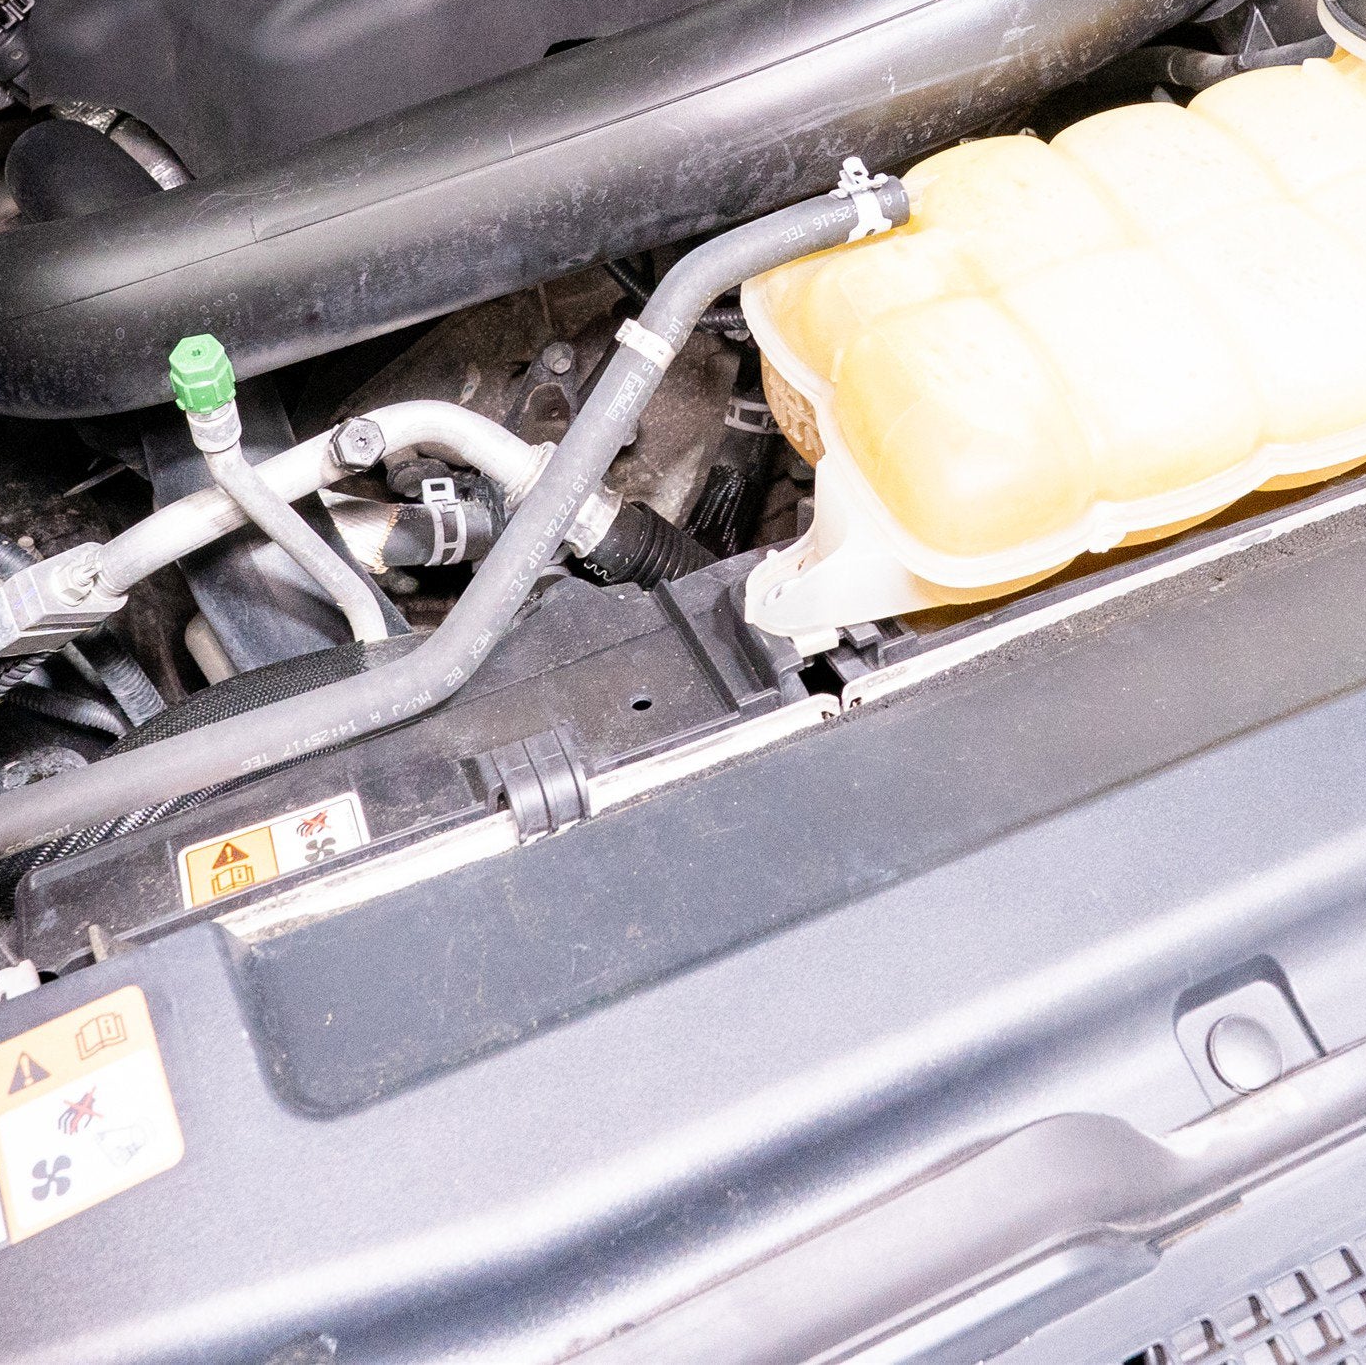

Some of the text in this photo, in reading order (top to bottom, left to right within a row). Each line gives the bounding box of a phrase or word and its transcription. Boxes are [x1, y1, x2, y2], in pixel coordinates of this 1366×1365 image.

[812, 204, 858, 231] :25:16
[781, 224, 807, 244] TEC
[526, 539, 548, 571] CIP
[469, 628, 493, 660] MEX
[370, 711, 382, 724] A
[284, 719, 357, 757] 14:25:17
[240, 751, 272, 771] TEC
